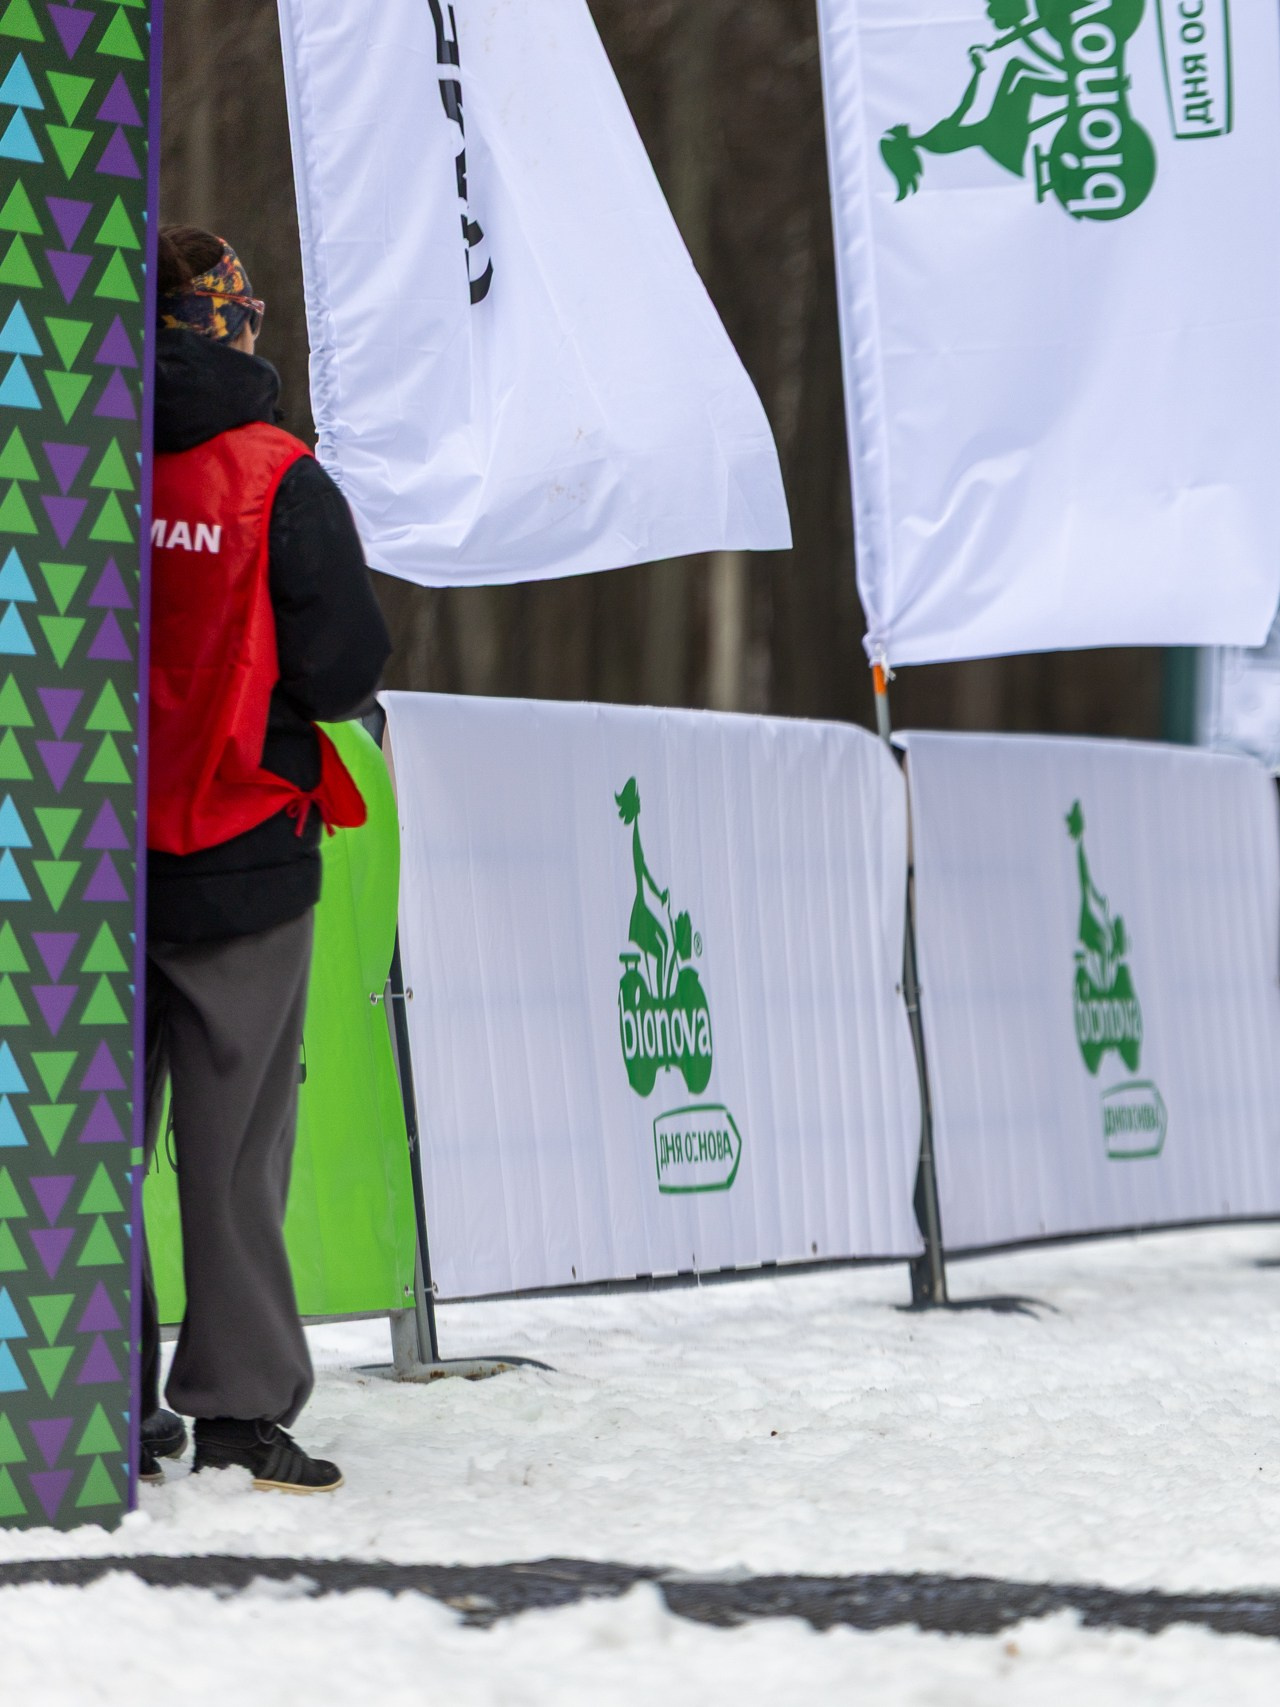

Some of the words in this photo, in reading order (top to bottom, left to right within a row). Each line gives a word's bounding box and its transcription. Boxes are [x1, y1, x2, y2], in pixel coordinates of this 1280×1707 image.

[1180, 53, 1214, 125] ДНЯ
[619, 984, 712, 1059] bionova
[659, 1132, 684, 1171] ДНЯ
